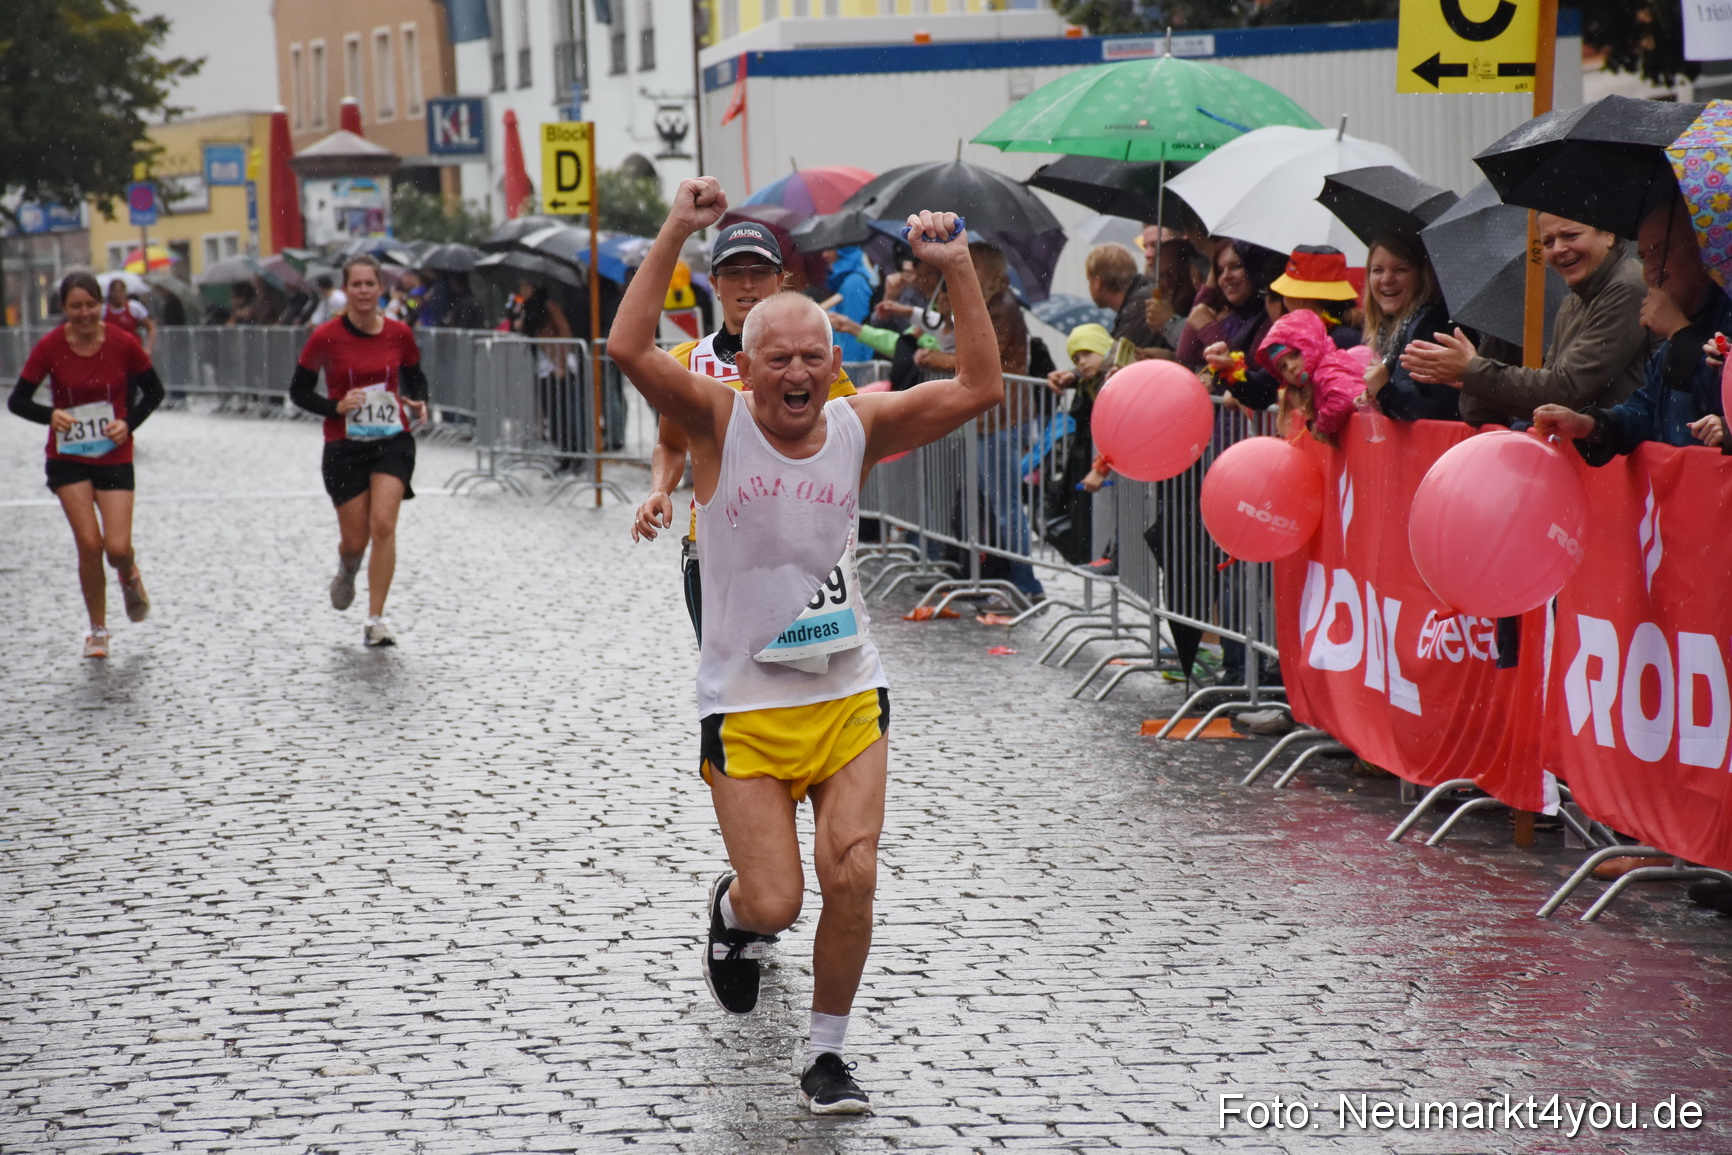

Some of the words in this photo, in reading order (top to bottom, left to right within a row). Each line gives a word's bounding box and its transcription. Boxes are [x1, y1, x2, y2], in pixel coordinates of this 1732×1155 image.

[546, 126, 589, 143] Block
[556, 150, 582, 193] D
[730, 228, 763, 239] MUSTO
[352, 404, 395, 424] 2142
[777, 621, 840, 644] Andreas
